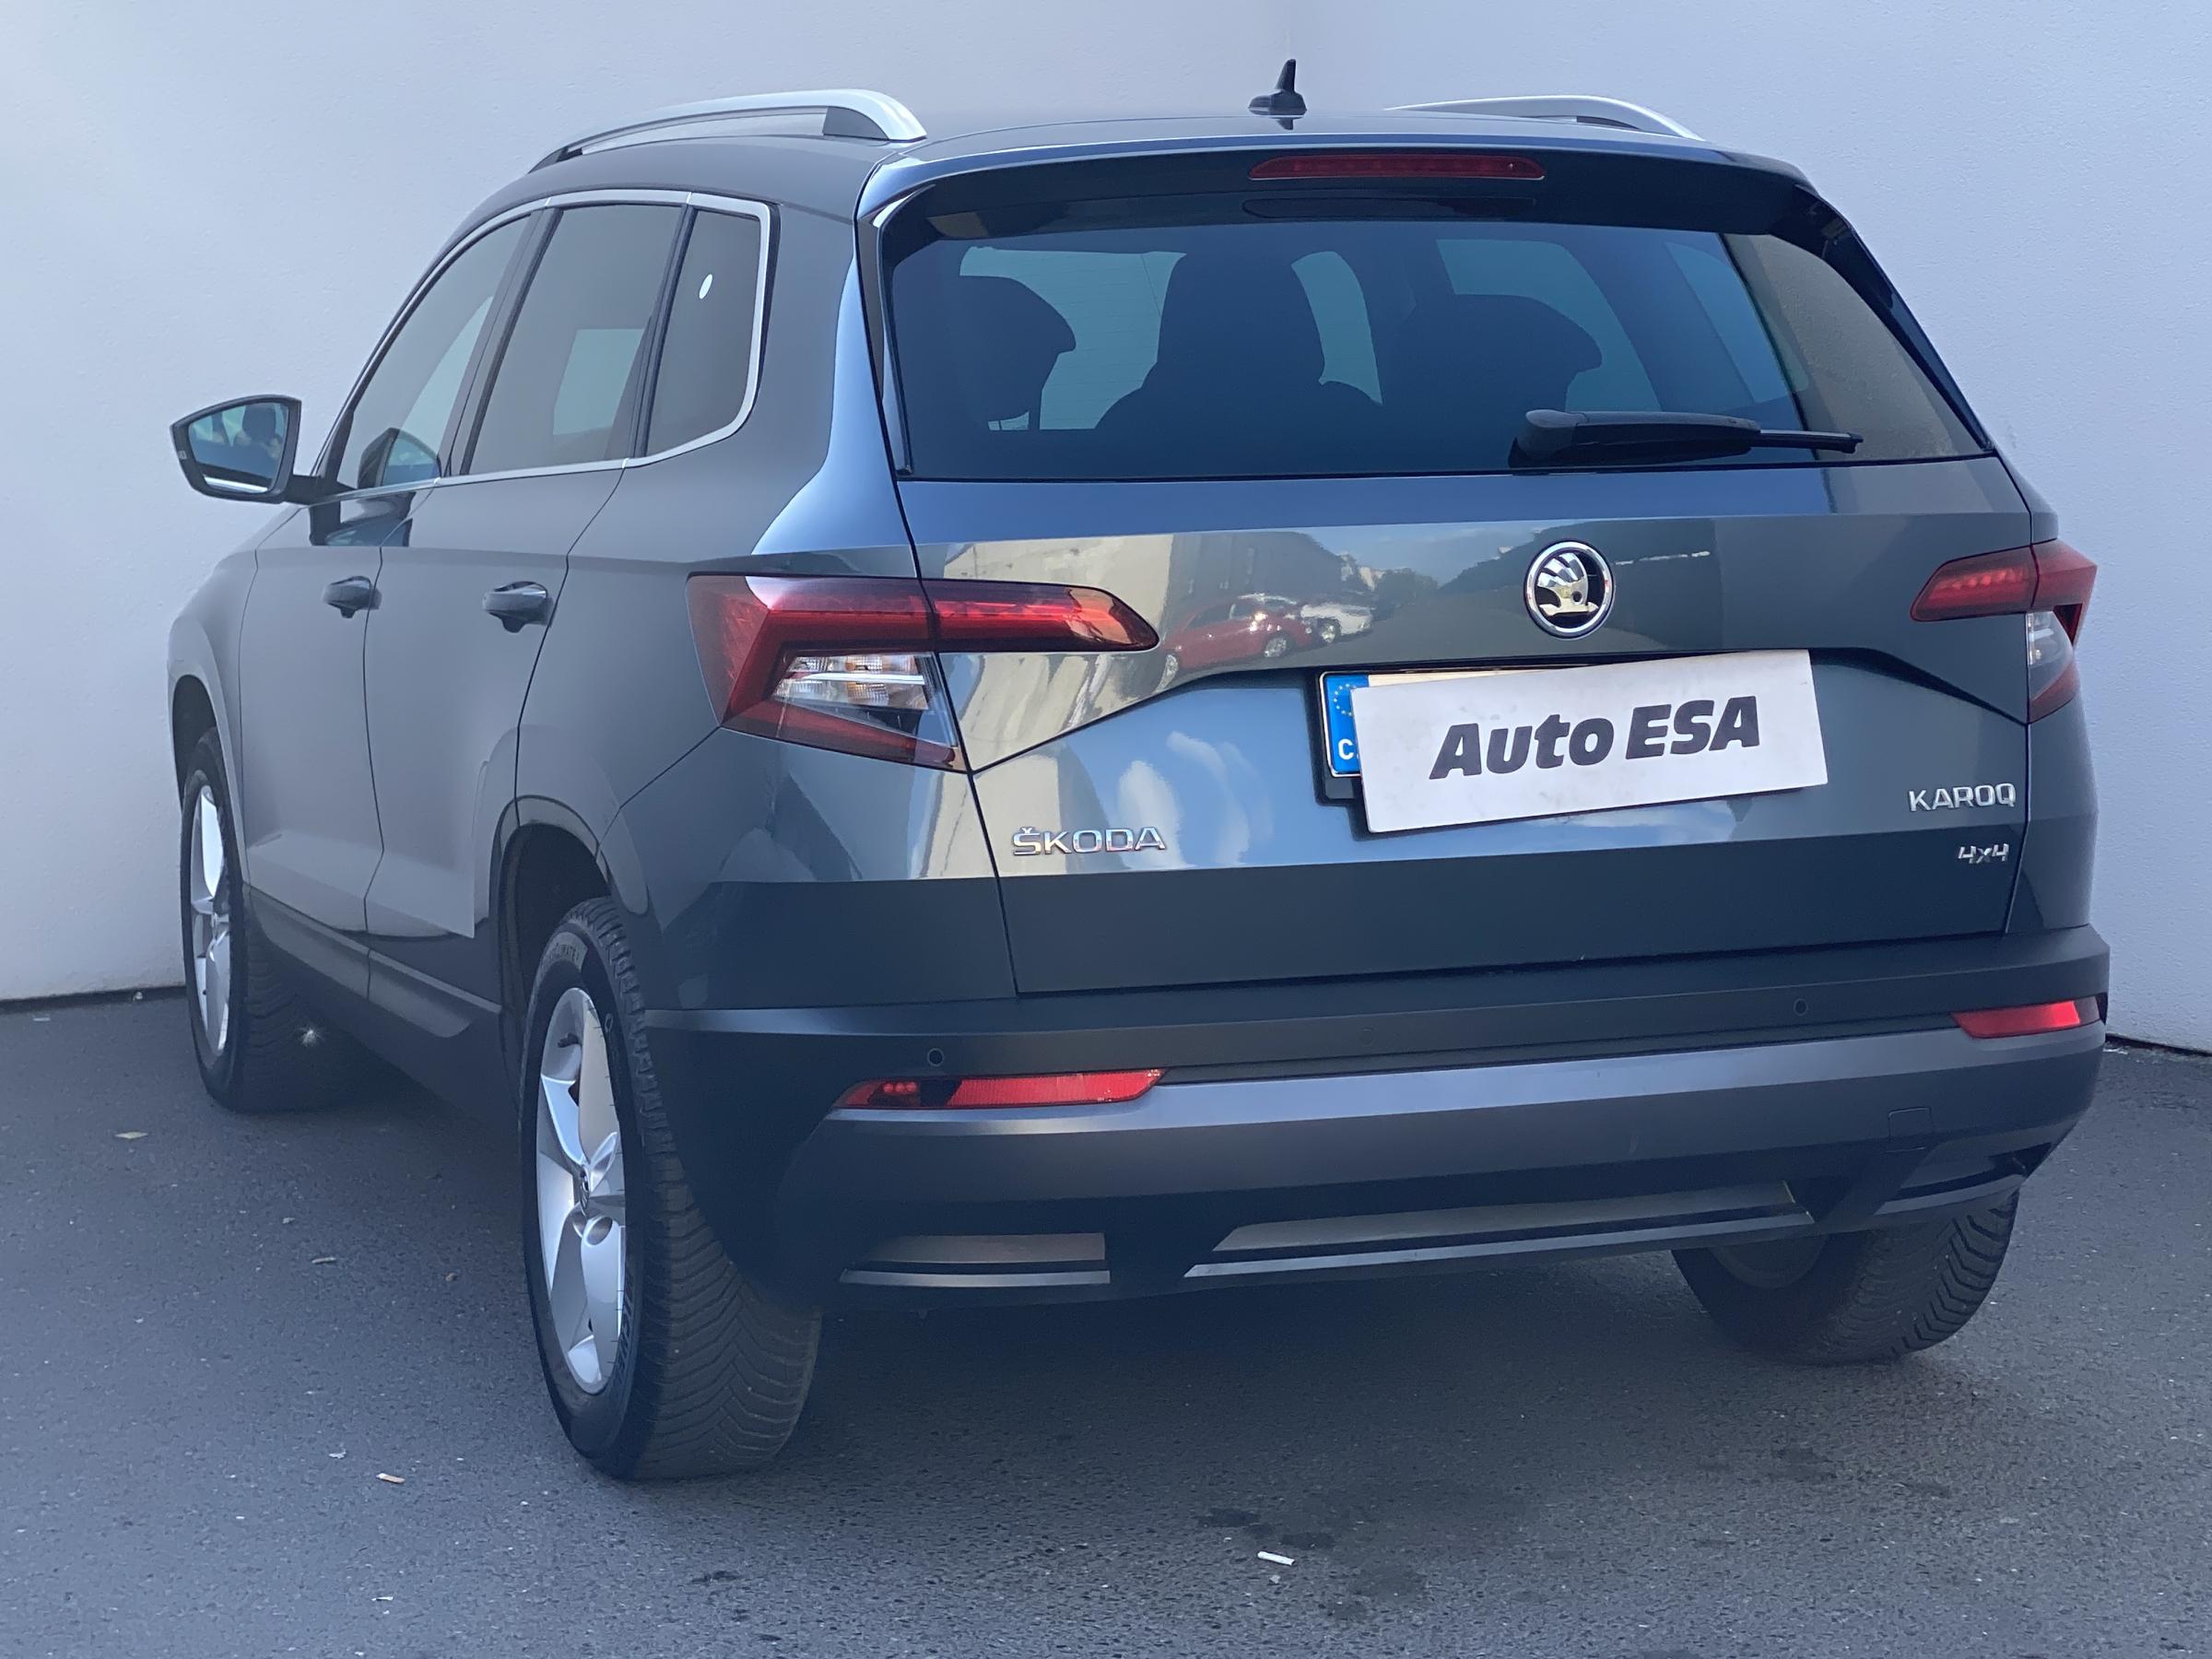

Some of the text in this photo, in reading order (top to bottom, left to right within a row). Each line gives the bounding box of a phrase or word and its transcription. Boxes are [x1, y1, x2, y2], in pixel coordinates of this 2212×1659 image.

[1338, 738, 1359, 759] C
[1430, 696, 1759, 780] Auto ESA
[1909, 782, 2016, 812] KAROQ
[1013, 827, 1166, 855] ŠKODA
[1958, 843, 2009, 865] 4x4
